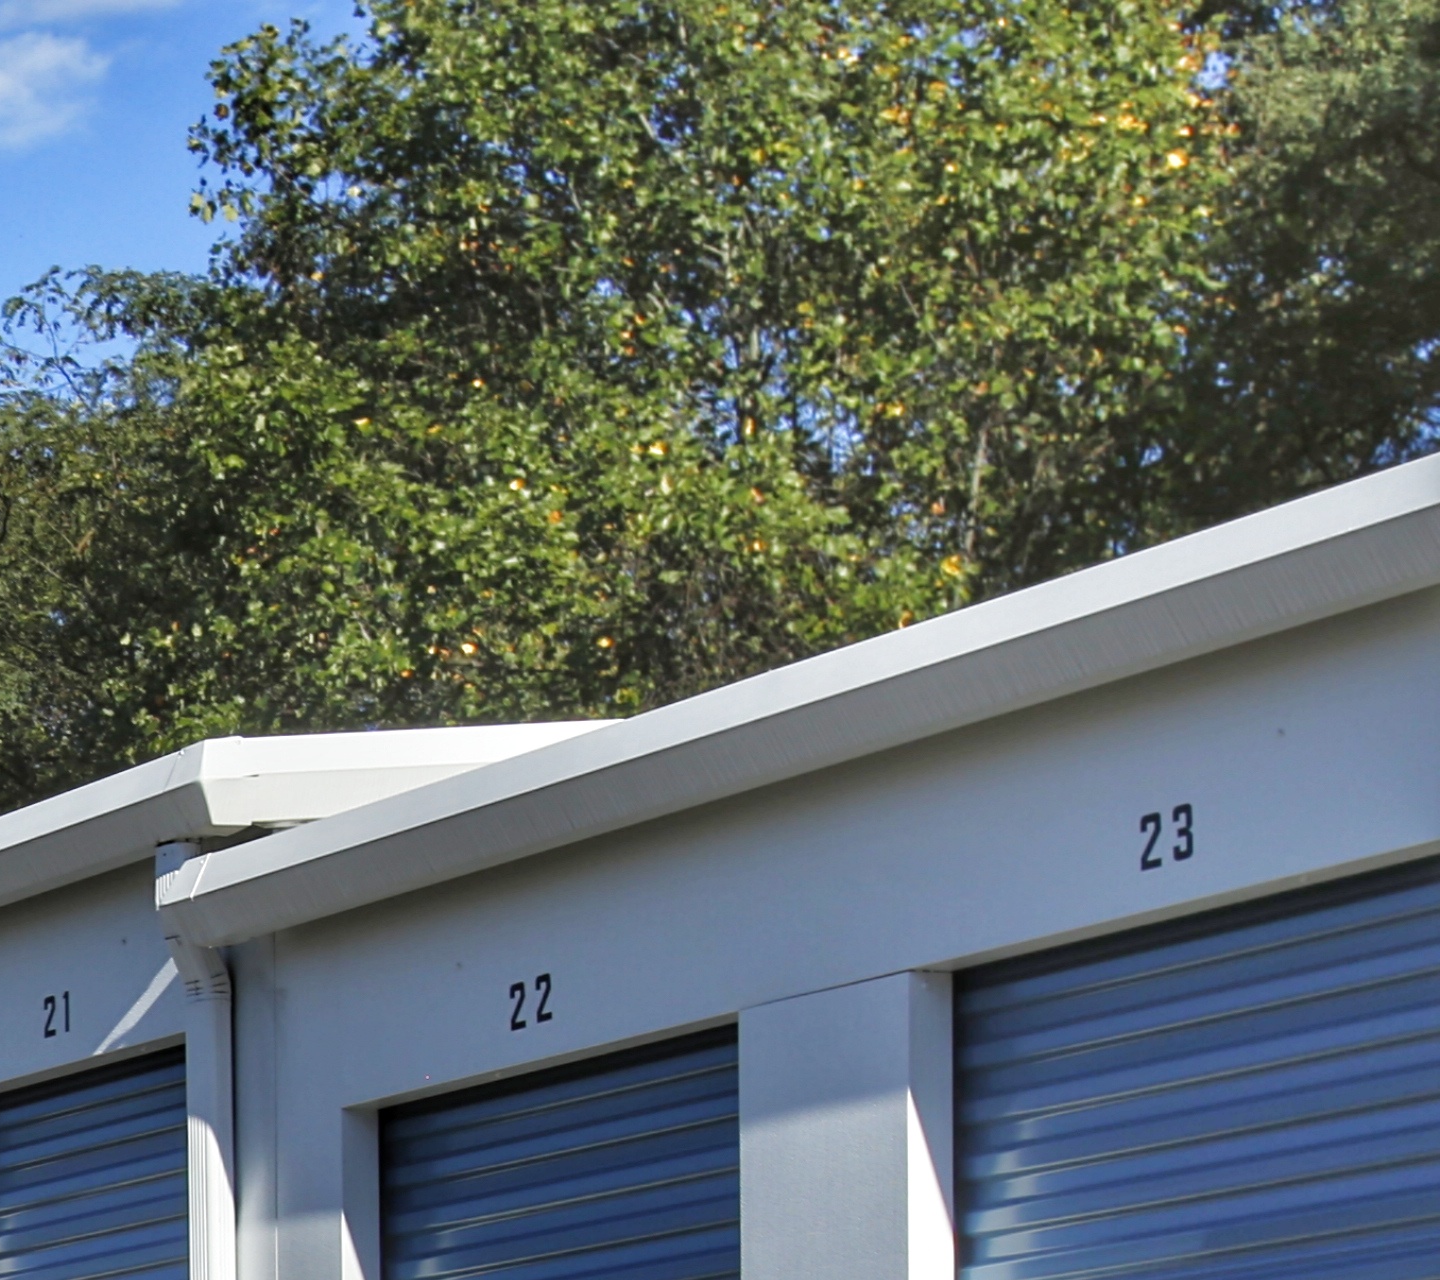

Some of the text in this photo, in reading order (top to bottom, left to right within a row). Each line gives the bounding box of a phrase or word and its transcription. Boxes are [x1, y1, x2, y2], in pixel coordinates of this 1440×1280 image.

[1139, 802, 1194, 872] 23
[43, 990, 71, 1039] 21
[509, 972, 553, 1032] 22
